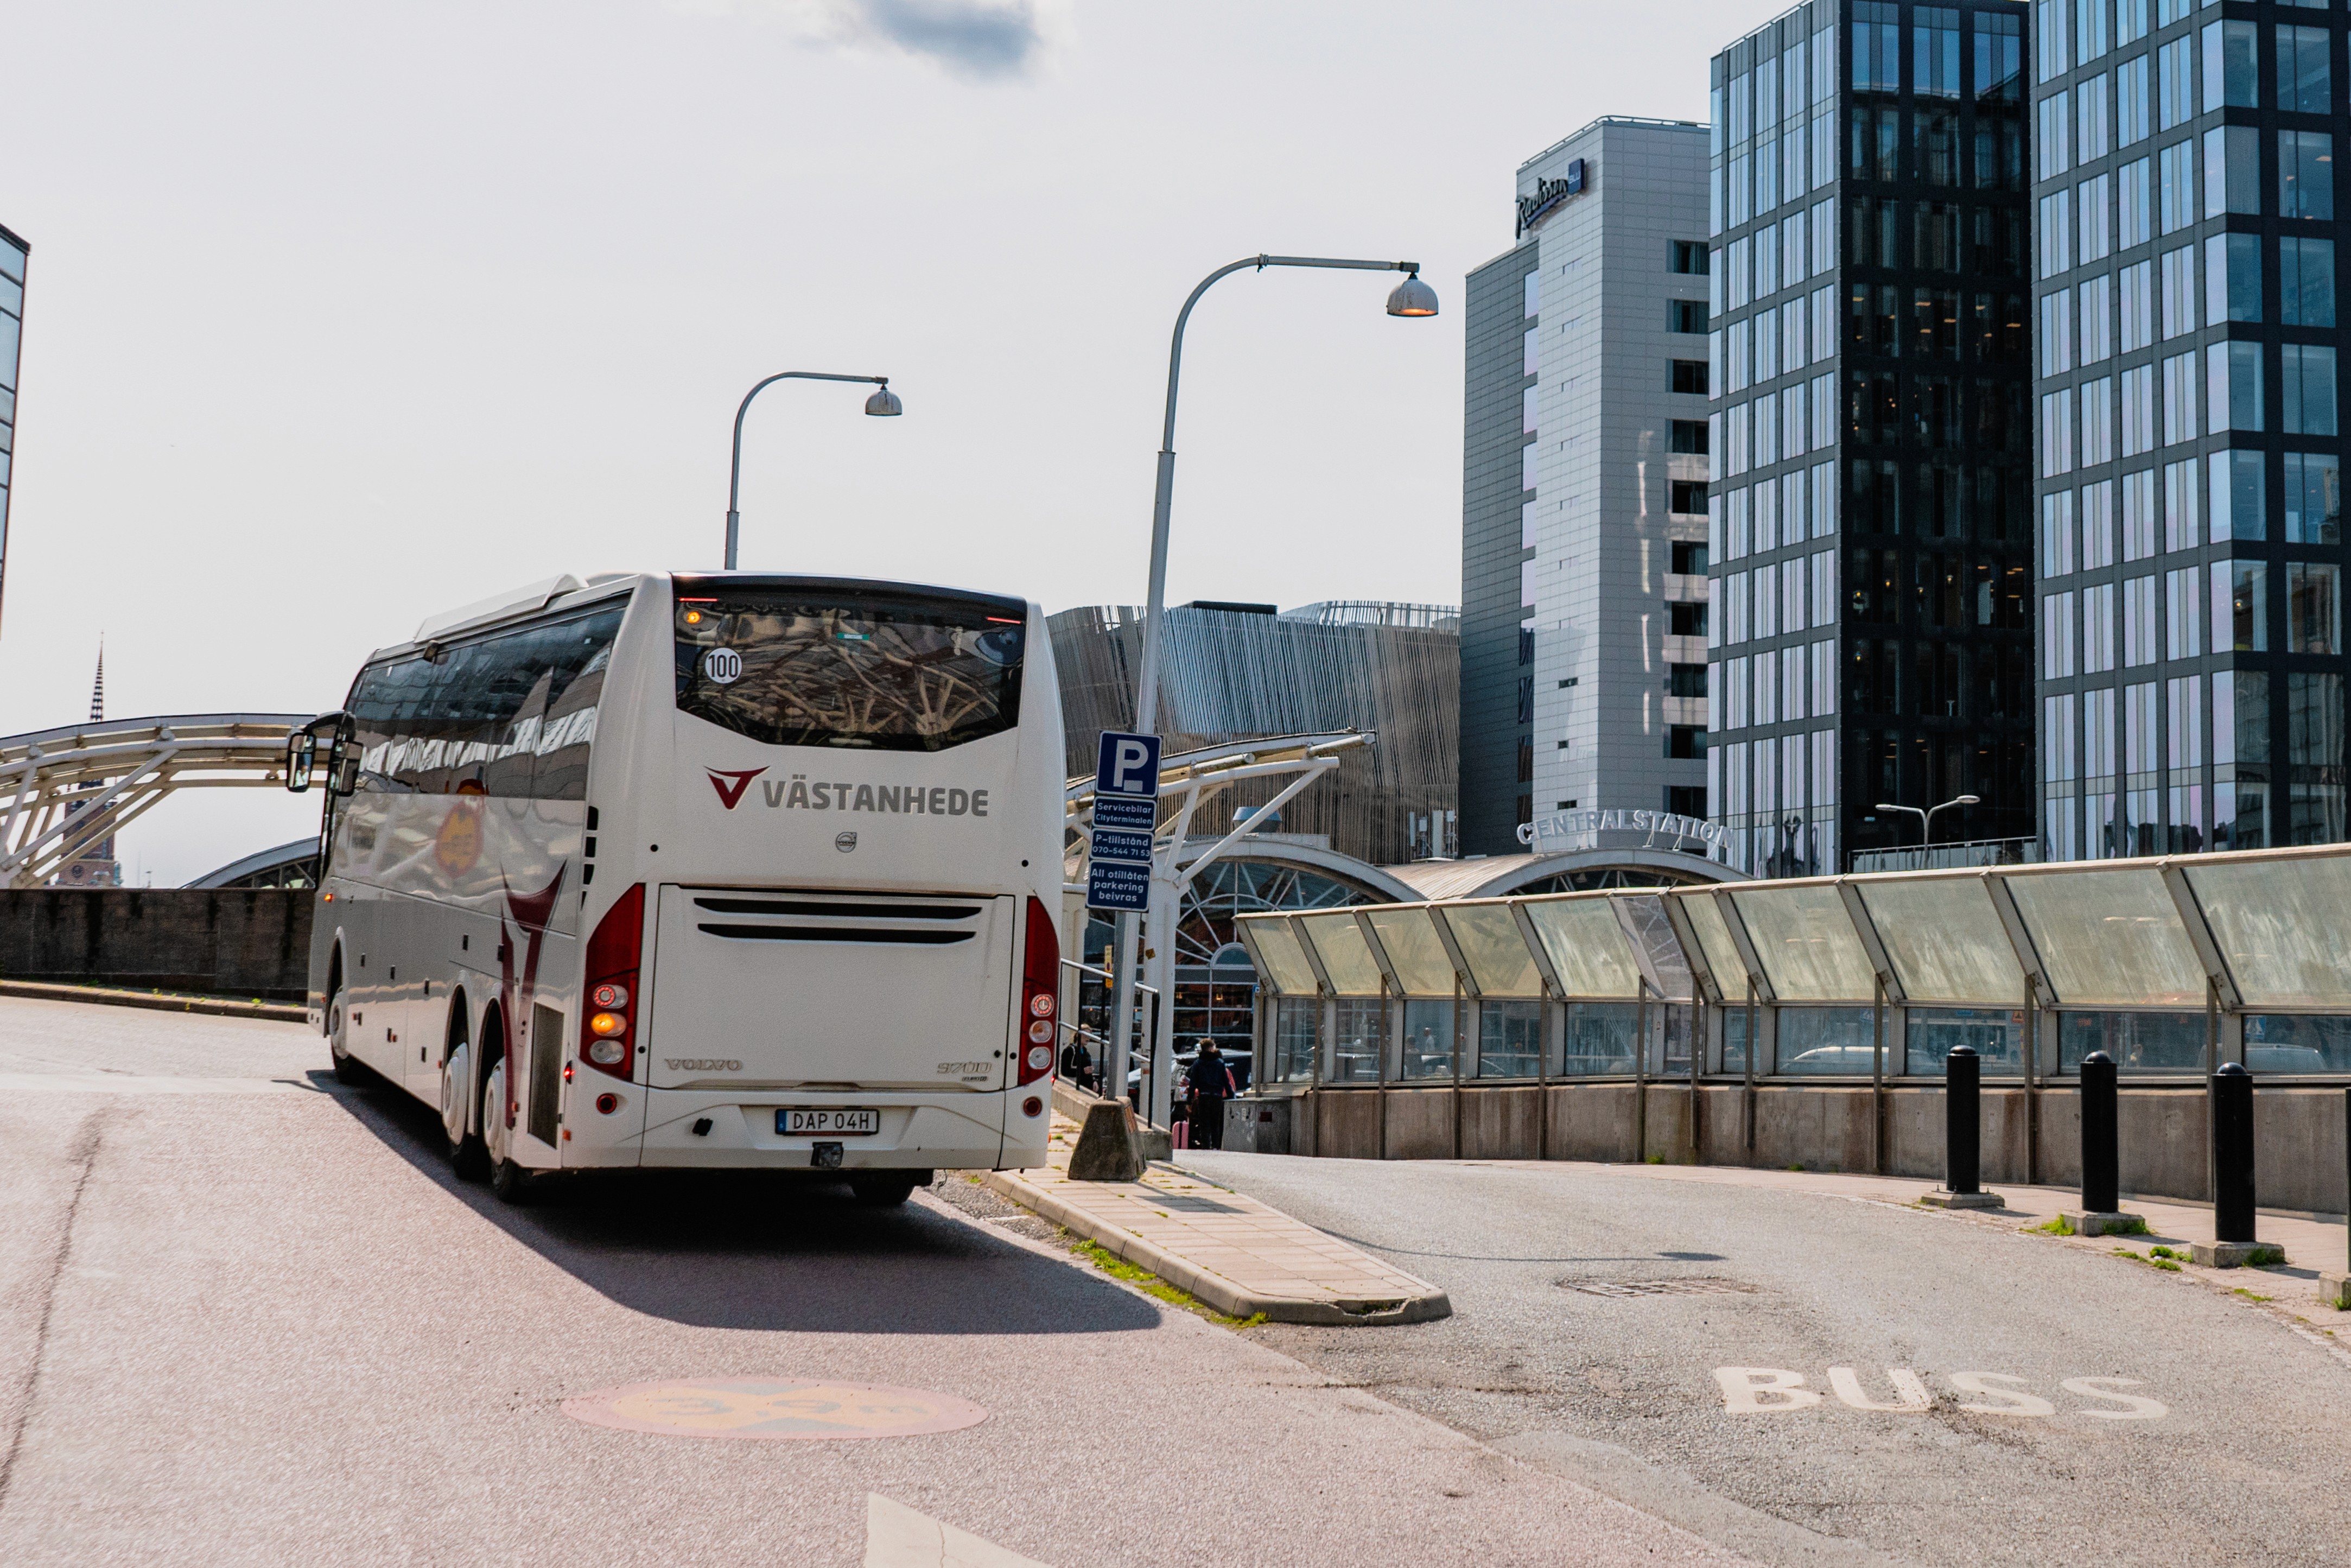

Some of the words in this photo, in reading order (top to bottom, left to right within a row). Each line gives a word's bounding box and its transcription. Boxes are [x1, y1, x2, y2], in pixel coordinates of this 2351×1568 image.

[1569, 170, 1580, 185] BLU
[708, 654, 738, 678] 100
[1113, 739, 1149, 788] P
[763, 775, 989, 817] VÄSTANHEDE
[1097, 802, 1152, 814] Servicebilar
[1096, 814, 1152, 824] Cityterminalen
[1516, 809, 1734, 849] CENTRALSTATION
[1096, 834, 1149, 847] P-tillstånd
[1092, 846, 1128, 855] 070-544
[1091, 868, 1105, 877] All
[1108, 871, 1149, 881] otillåten
[1094, 881, 1144, 893] parkering
[1098, 891, 1138, 902] beivras
[664, 1058, 743, 1071] VOLVO
[937, 1062, 993, 1074] 9700
[793, 1113, 828, 1129] DAP
[835, 1113, 869, 1129] 04H
[1715, 1366, 2169, 1420] BUSS
